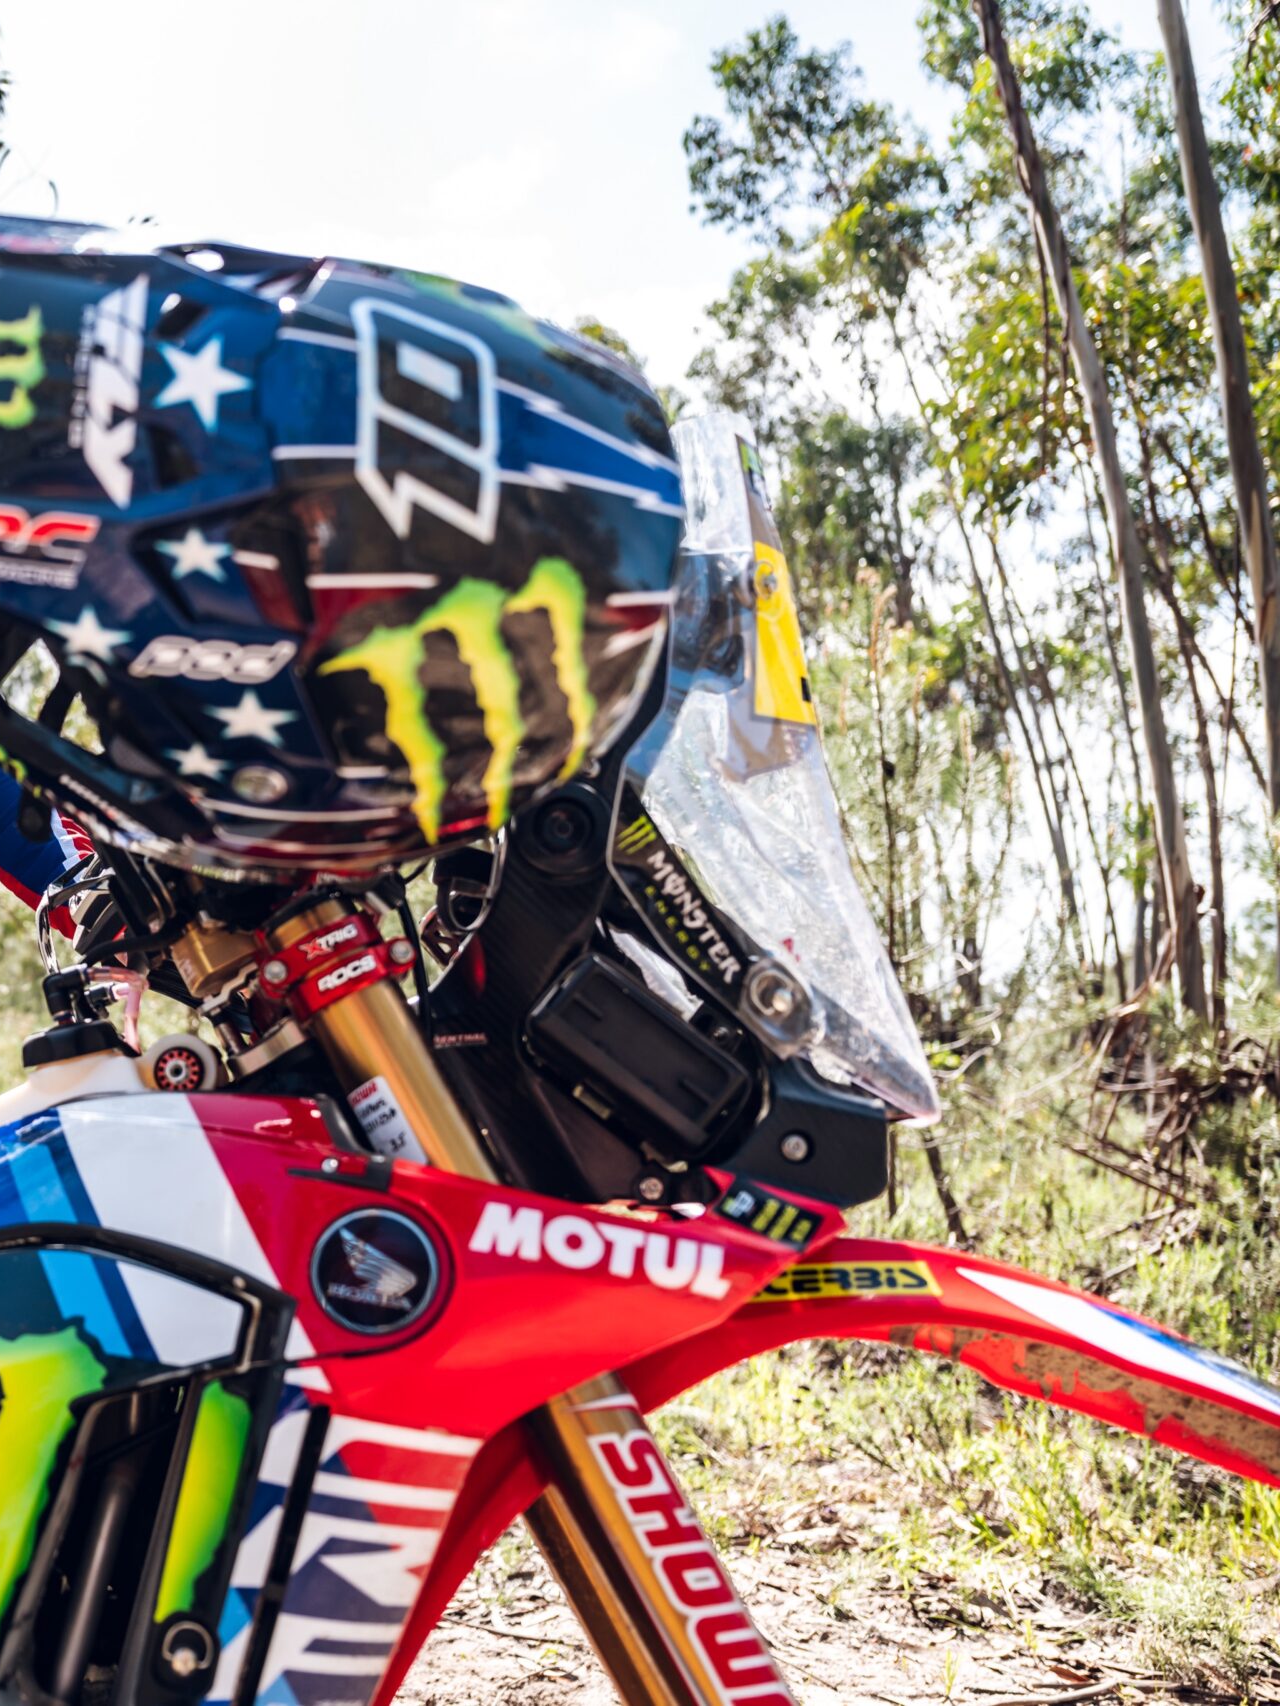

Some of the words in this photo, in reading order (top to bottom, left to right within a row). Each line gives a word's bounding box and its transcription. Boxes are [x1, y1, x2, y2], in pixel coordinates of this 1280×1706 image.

[647, 849, 741, 984] MONSTER
[316, 953, 377, 993] ROCS
[468, 1202, 731, 1300] MOTUL
[760, 1267, 929, 1296] CERBIS
[590, 1432, 798, 1706] SHOW
